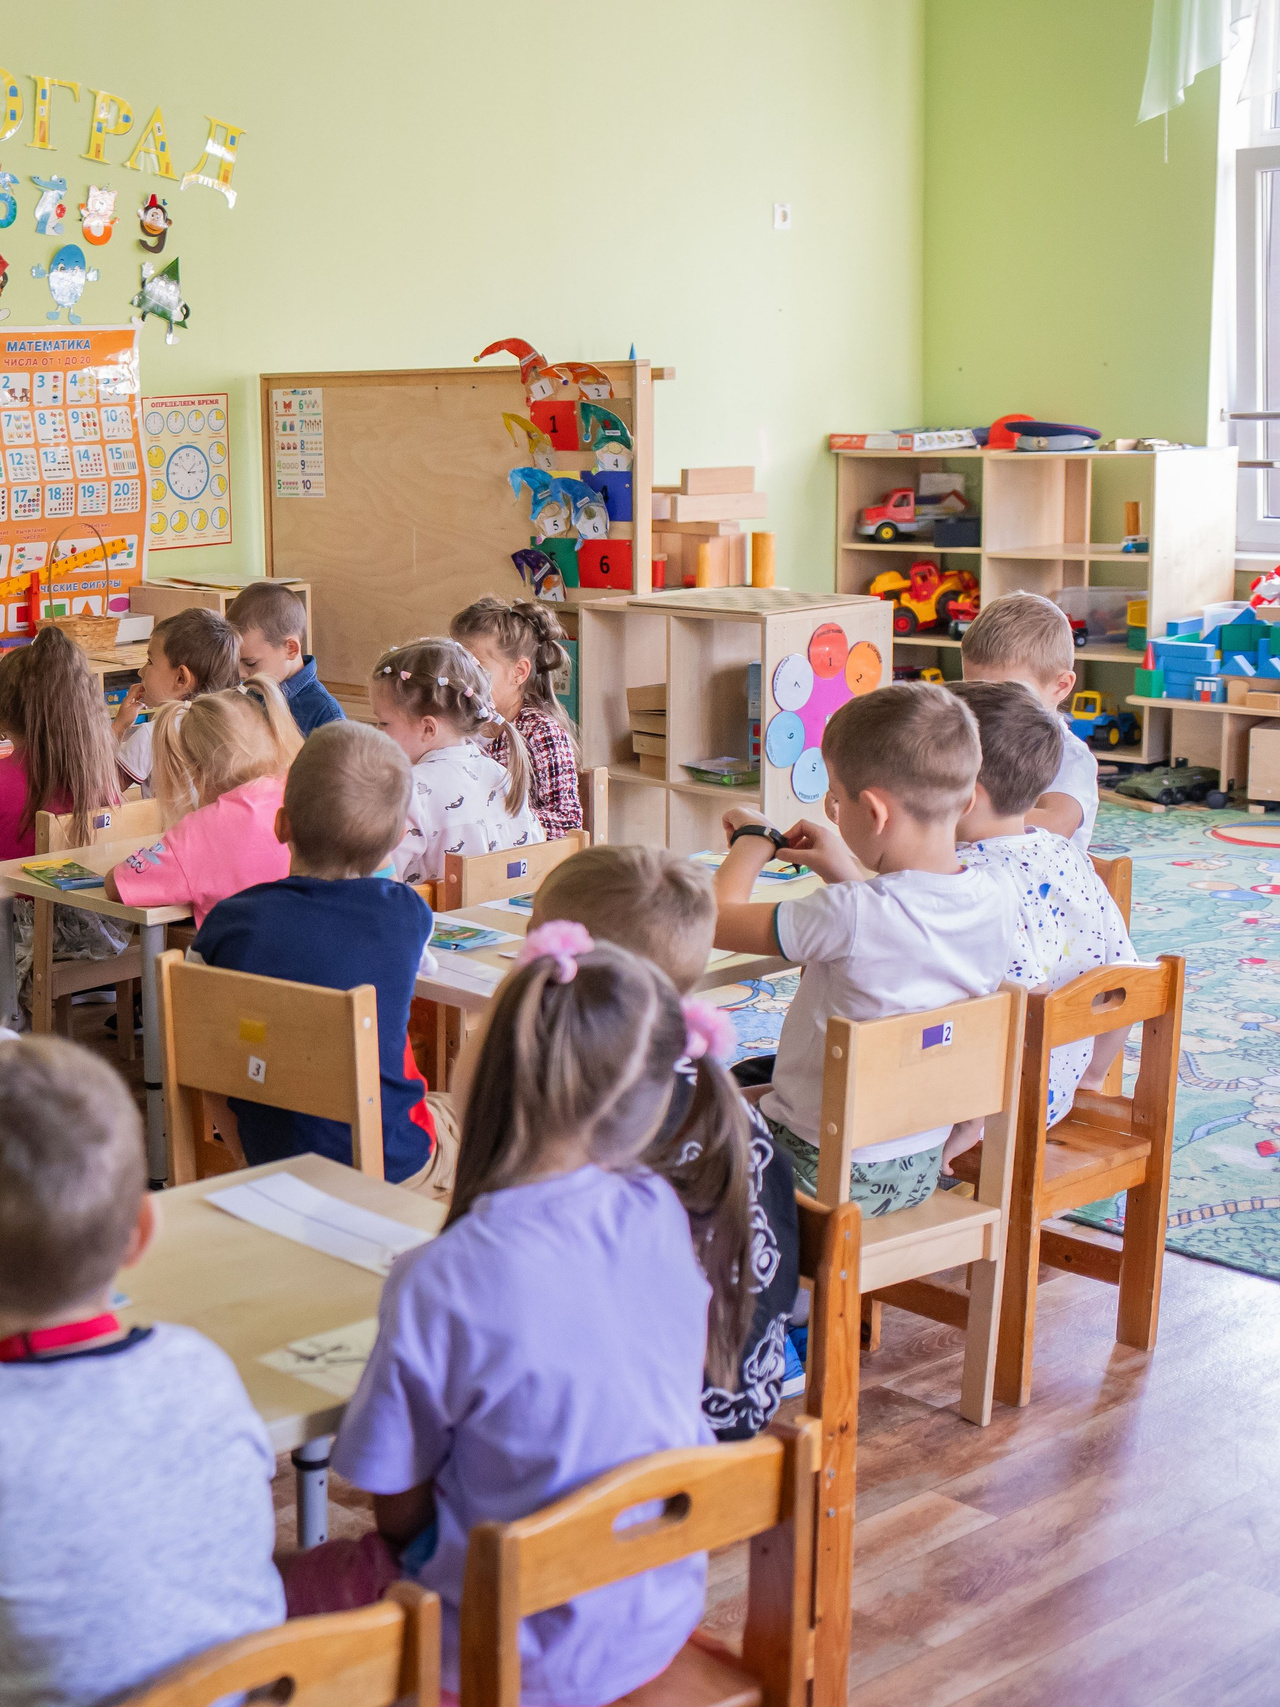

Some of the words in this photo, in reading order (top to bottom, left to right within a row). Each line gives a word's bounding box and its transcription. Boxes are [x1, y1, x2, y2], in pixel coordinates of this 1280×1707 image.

[80, 184, 120, 246] 8
[136, 194, 173, 254] 9
[5, 339, 91, 352] МАТЕМАТИКА
[4, 357, 38, 367] ЧИСЛА
[41, 357, 54, 367] ОТ
[57, 357, 62, 366] 1
[65, 356, 78, 366] ДО
[80, 356, 91, 365] 20
[2, 375, 11, 389] 2
[37, 375, 46, 388] 3
[70, 374, 78, 387] 4
[540, 385, 546, 395] 1
[595, 388, 602, 397] 2
[150, 399, 196, 409] ОПРЕДЕЛЯЕМ
[197, 399, 220, 407] ВРЕМЯ
[275, 401, 278, 411] 1
[298, 399, 304, 410] 6
[4, 414, 12, 427] 7
[38, 413, 47, 425] 8
[71, 411, 80, 423] 9
[104, 409, 118, 422] 10
[275, 420, 279, 430] 2
[300, 420, 304, 430] 7
[549, 415, 559, 433] 1
[276, 441, 280, 450] 3
[300, 440, 305, 450] 8
[9, 453, 24, 466] 12
[42, 451, 57, 463] 13
[76, 449, 90, 462] 14
[109, 447, 123, 460] 15
[277, 460, 281, 470] 4
[301, 459, 306, 470] 9
[546, 457, 552, 468] 3
[613, 458, 619, 468] 4
[277, 479, 282, 490] 5
[301, 479, 312, 490] 10
[13, 489, 28, 503] 17
[48, 487, 62, 500] 18
[81, 485, 95, 498] 19
[114, 483, 130, 496] 20
[553, 520, 559, 531] 5
[593, 524, 599, 533] 6
[600, 555, 610, 574] 6
[829, 657, 833, 667] 1
[856, 674, 863, 683] 2
[794, 681, 801, 689] 7
[811, 763, 817, 772] 5
[105, 816, 111, 826] 2
[521, 861, 527, 876] 2
[944, 1026, 952, 1042] 2
[253, 1062, 262, 1078] 3
